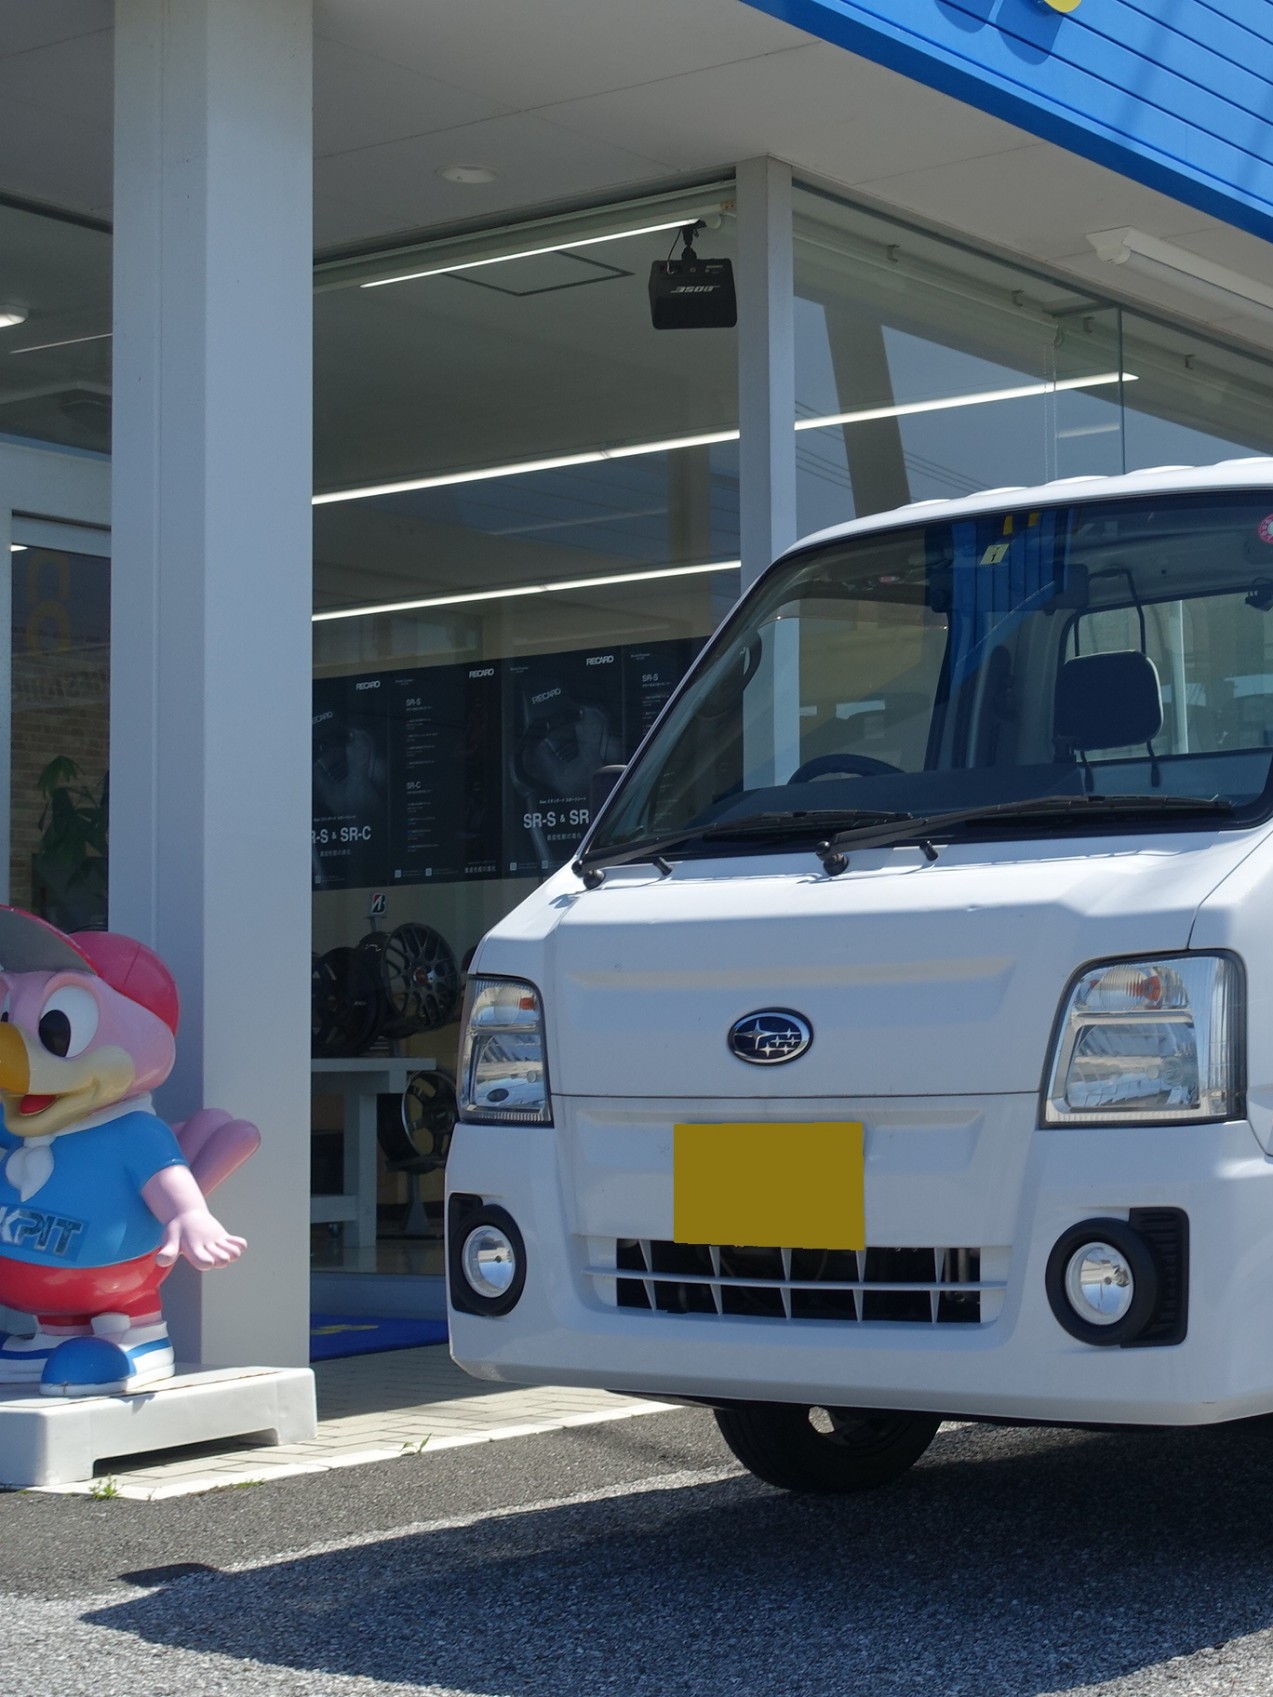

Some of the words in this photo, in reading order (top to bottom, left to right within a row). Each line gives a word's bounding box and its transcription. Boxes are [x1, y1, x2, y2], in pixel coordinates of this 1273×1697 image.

[586, 655, 613, 666] RECARO
[523, 812, 556, 828] SR-S
[340, 826, 371, 842] SR-C
